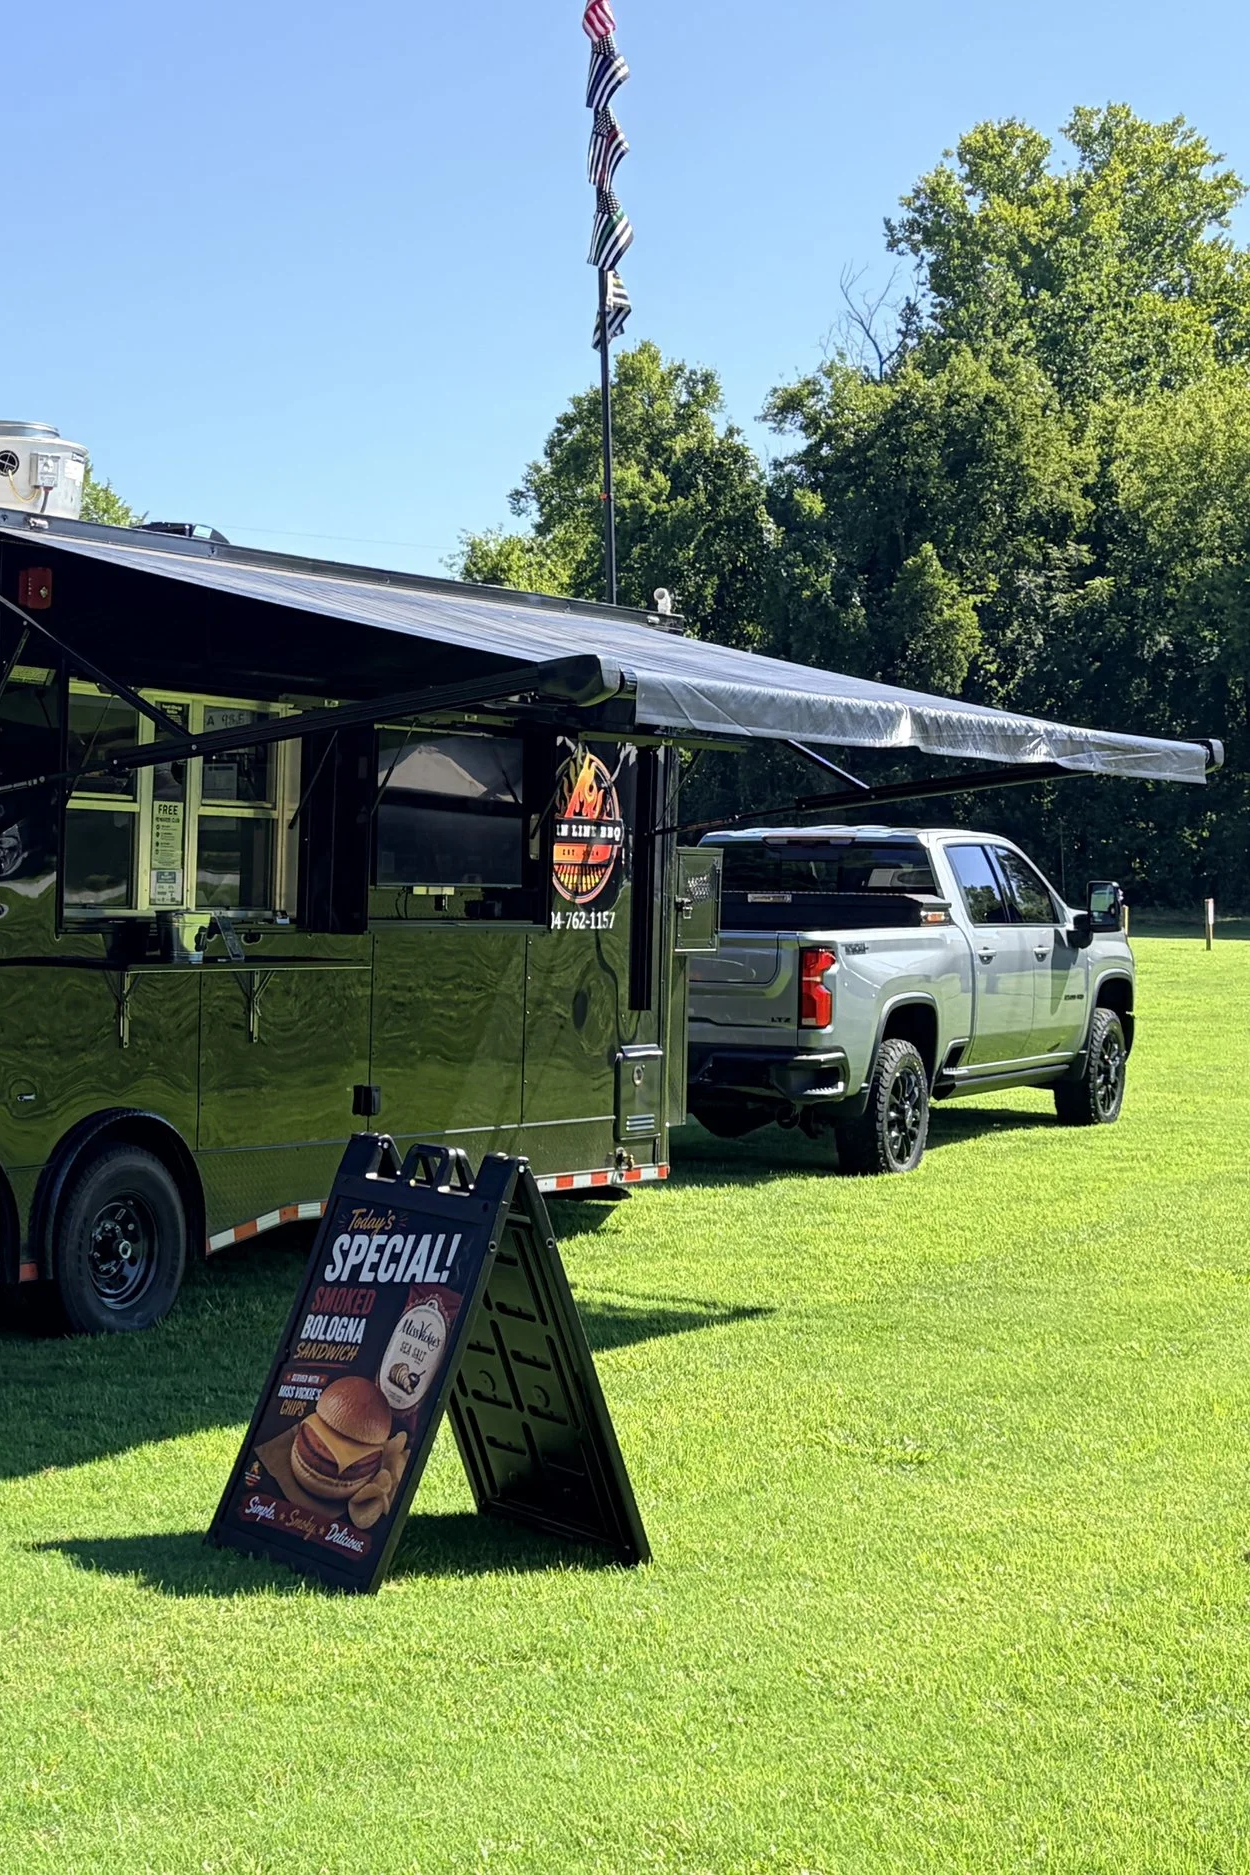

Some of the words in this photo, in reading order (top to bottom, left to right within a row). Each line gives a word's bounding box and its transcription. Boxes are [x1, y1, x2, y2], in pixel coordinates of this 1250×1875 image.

[158, 804, 179, 815] FREE
[572, 824, 597, 837] LINE
[600, 826, 621, 841] BBQ
[551, 911, 615, 930] 4-762-1157
[348, 1208, 396, 1238] Today's
[324, 1233, 462, 1283] SPECIAL!
[311, 1286, 377, 1315] SMOKED
[300, 1314, 367, 1344] BOLOGNA
[293, 1341, 360, 1362] SANDWICH
[400, 1341, 412, 1356] SEA
[412, 1347, 427, 1362] SALT
[291, 1373, 308, 1383] SERVED
[308, 1375, 320, 1384] WITH
[278, 1384, 296, 1398] MISS
[294, 1386, 322, 1400] VICKIE'S
[279, 1399, 307, 1417] CHIPS
[325, 1523, 365, 1553] Delicious.
